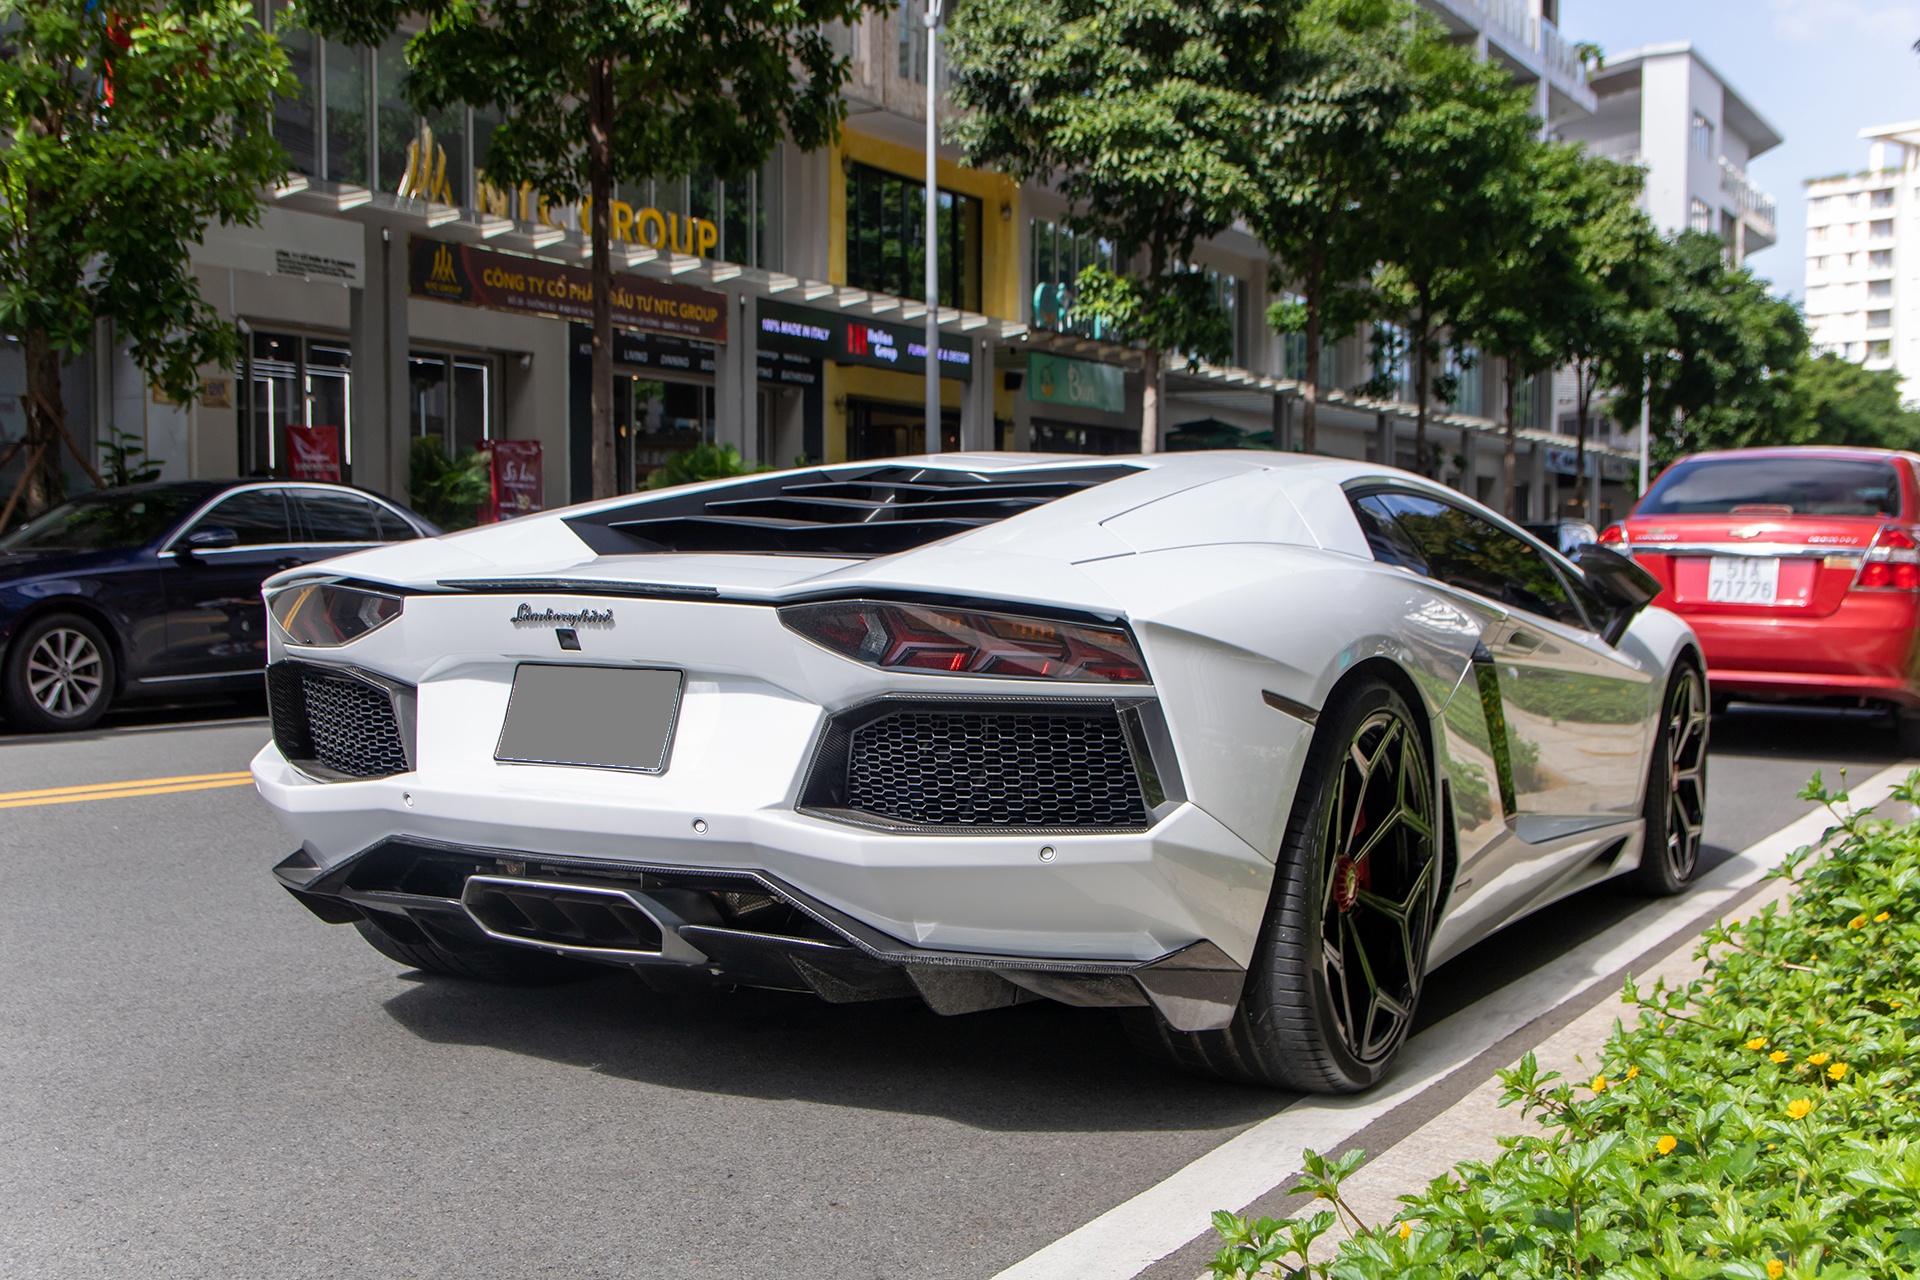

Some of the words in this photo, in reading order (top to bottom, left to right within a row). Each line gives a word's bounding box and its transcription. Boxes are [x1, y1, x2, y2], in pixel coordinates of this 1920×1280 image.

[483, 266, 525, 292] CÔNG
[527, 276, 545, 295] TY
[547, 273, 567, 298] CỔ
[654, 298, 678, 317] NTC
[679, 303, 718, 323] GROUP
[781, 321, 802, 337] MADE
[802, 324, 810, 338] IN
[810, 326, 831, 341] ITALY
[510, 602, 614, 627] Lamborghini
